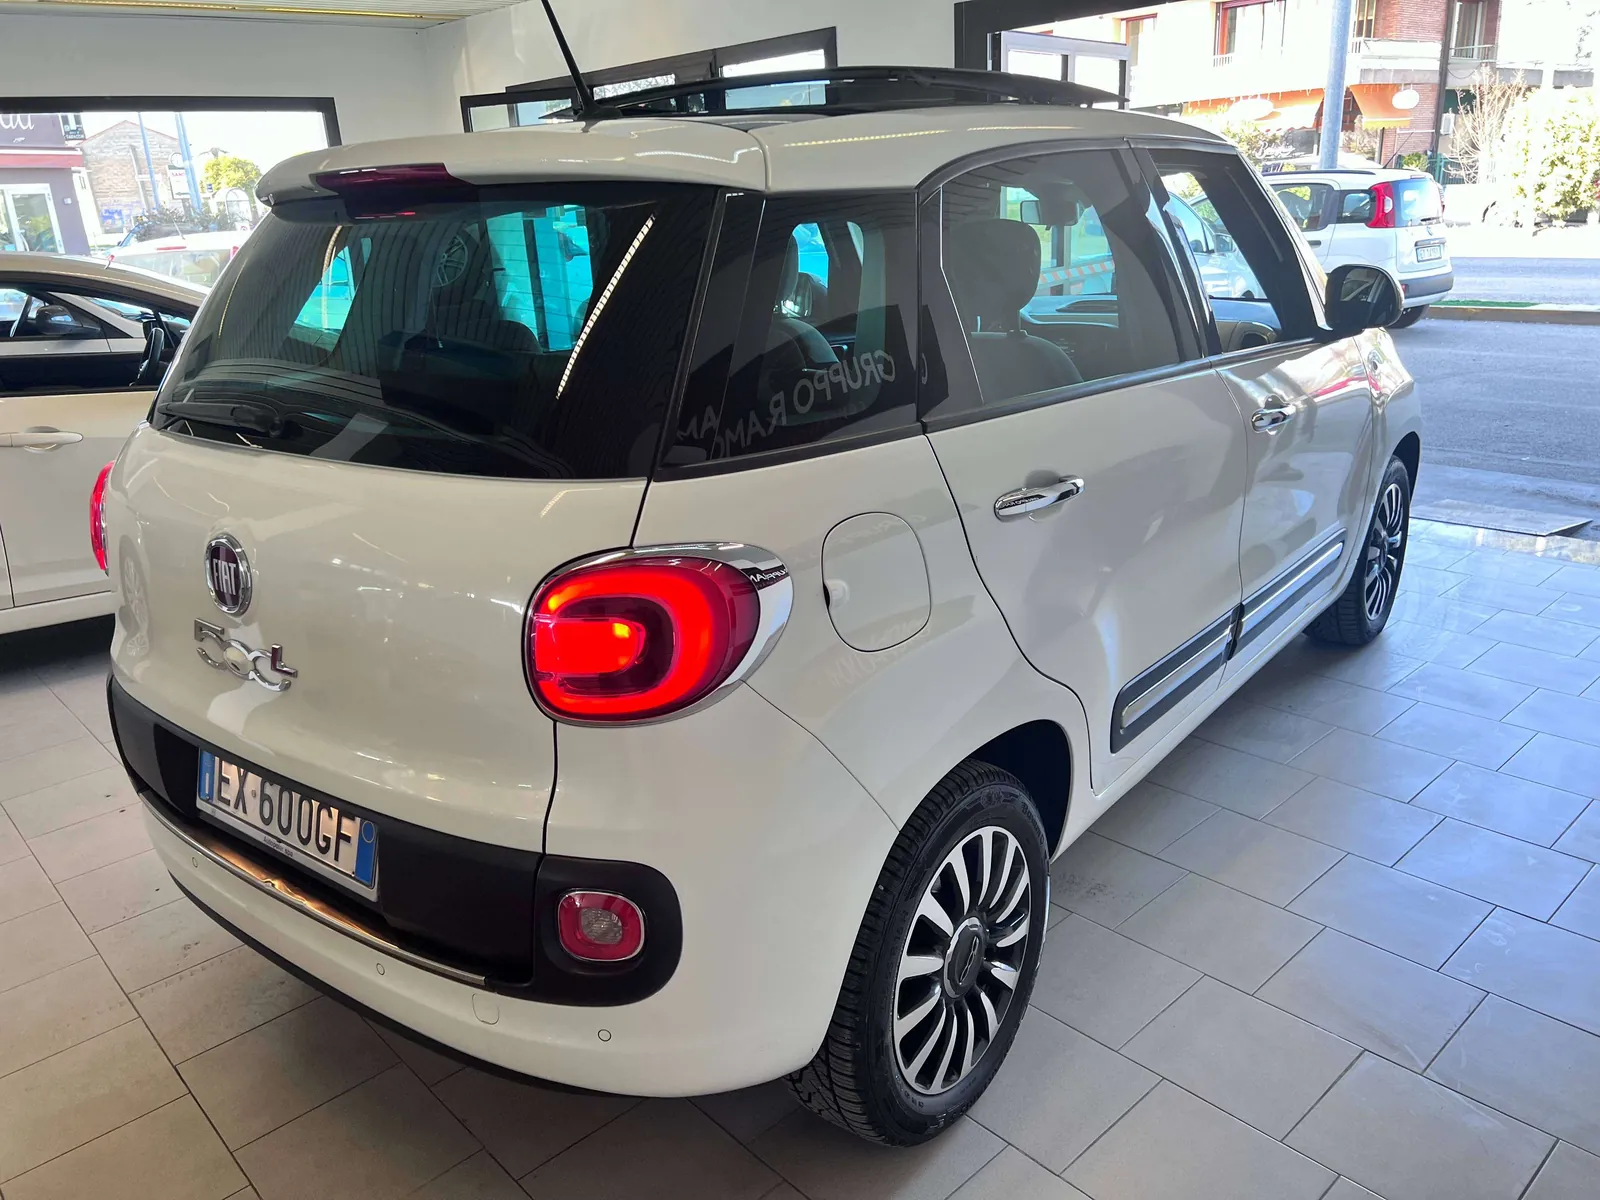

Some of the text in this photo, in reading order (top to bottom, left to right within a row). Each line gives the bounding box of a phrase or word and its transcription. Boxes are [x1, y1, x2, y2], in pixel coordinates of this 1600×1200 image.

[212, 558, 237, 595] FIAT
[194, 617, 298, 692] 500L
[216, 758, 356, 862] EX 600GF
